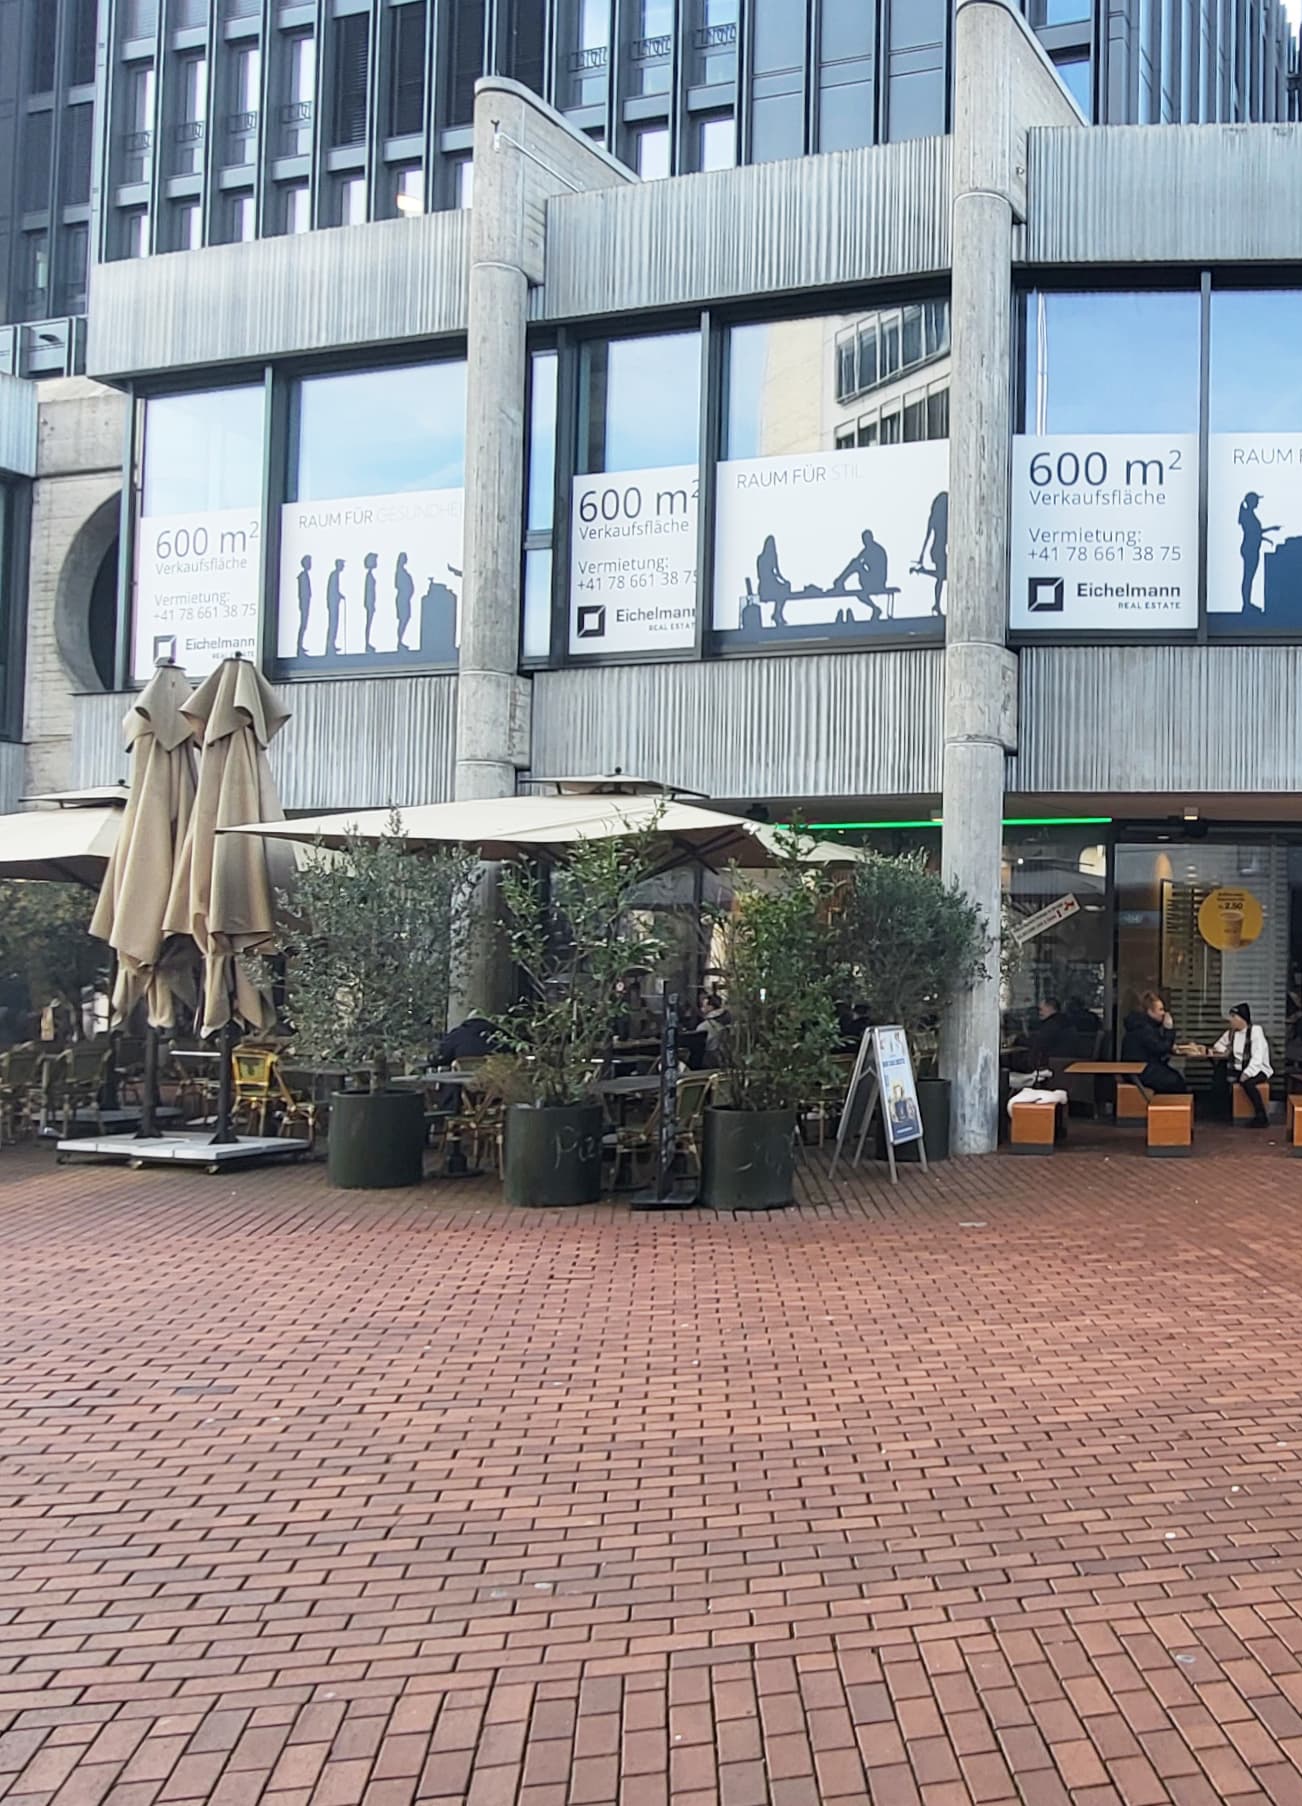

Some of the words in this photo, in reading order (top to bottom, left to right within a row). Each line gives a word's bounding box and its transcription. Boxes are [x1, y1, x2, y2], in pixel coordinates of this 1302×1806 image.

[1233, 447, 1293, 464] RAUM
[737, 471, 788, 489] RAUM
[792, 464, 827, 484] FÜR
[831, 463, 864, 481] STIL
[1030, 452, 1108, 487] 600
[580, 486, 642, 523] 600
[1029, 489, 1166, 506] Verkaufsfläche
[299, 511, 341, 529] RAUM
[376, 501, 458, 523] GESUNDHE
[579, 518, 690, 541] Verkaufsfläche
[1029, 527, 1142, 546] Vermietung:
[156, 527, 208, 559] 600
[1028, 547, 1058, 561] +41
[1067, 547, 1087, 561] 78
[1094, 547, 1124, 561] 661
[1132, 547, 1153, 561] 38
[1160, 547, 1181, 561] 75
[155, 556, 248, 576] Verkaufsfläche
[578, 556, 669, 575] Vermietung:
[578, 576, 602, 591] +41
[607, 575, 625, 590] 78
[630, 572, 656, 588] 661
[662, 571, 679, 586] 38
[1077, 582, 1181, 598] Eichelmann
[154, 591, 231, 608] Vermietung:
[1118, 601, 1141, 609] REAL
[1145, 601, 1181, 609] ESTATE
[154, 610, 175, 622] +41
[179, 607, 194, 620] 78
[197, 605, 218, 619] 661
[223, 604, 238, 618] 38
[242, 603, 257, 617] 75
[671, 622, 696, 631] ESTAT
[185, 636, 255, 651] Eichelmann
